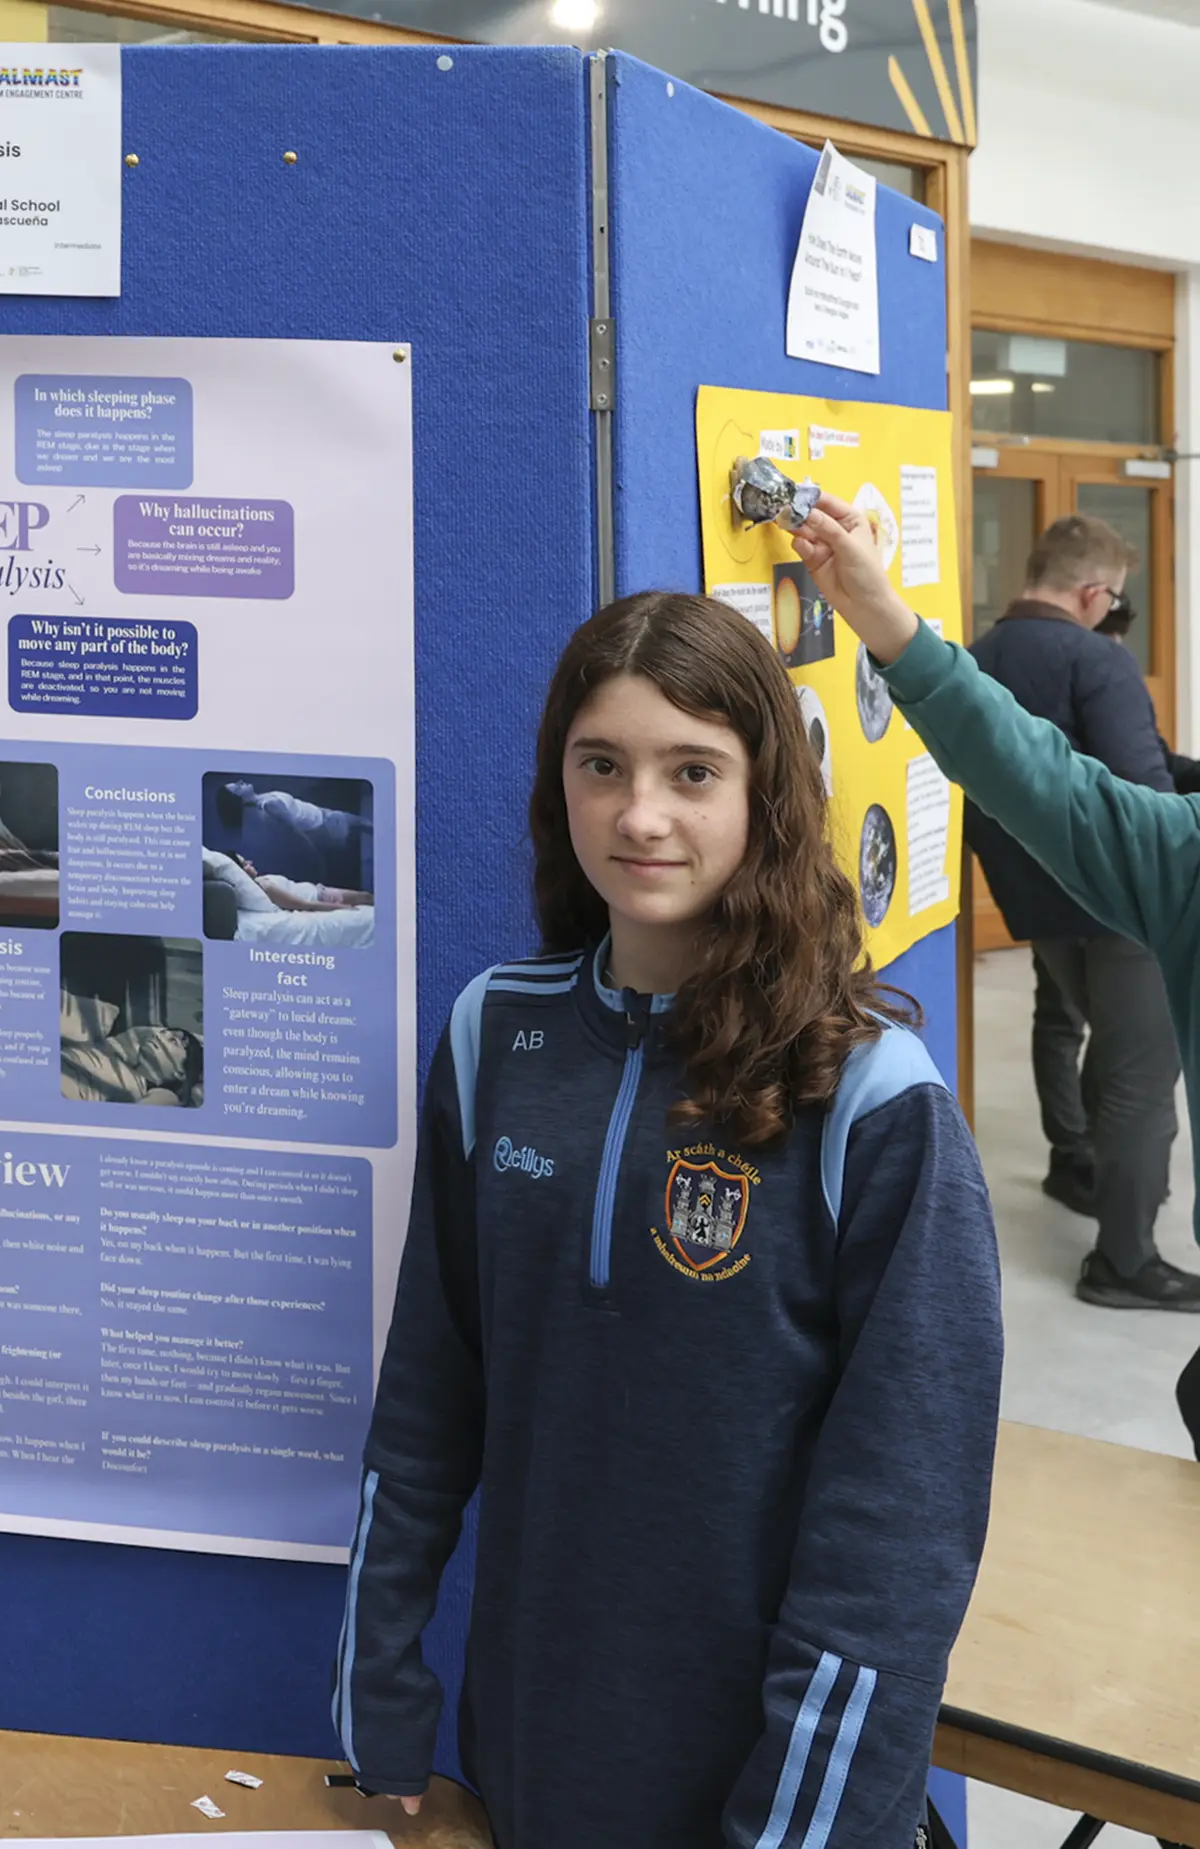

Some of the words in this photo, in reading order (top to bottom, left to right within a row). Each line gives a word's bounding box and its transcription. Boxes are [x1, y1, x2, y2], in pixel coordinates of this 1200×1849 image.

[5, 89, 53, 98] ENGAGEMENT
[55, 90, 82, 98] CENTRE
[10, 198, 60, 212] School
[35, 388, 47, 401] In
[50, 389, 85, 403] which
[88, 390, 138, 406] sleeping
[140, 391, 176, 407] phase
[54, 404, 82, 416] does
[85, 404, 94, 417] it
[96, 404, 152, 421] happens?
[139, 502, 170, 521] Why
[174, 504, 274, 520] hallucinations
[169, 525, 194, 536] can
[197, 523, 244, 537] occur?
[31, 620, 58, 638] Why
[94, 622, 103, 636] it
[107, 625, 159, 642] possible
[162, 628, 175, 640] to
[18, 639, 52, 650] move
[54, 640, 77, 654] any
[81, 641, 107, 655] part
[111, 637, 125, 652] of
[127, 640, 148, 654] the
[151, 641, 188, 658] body?
[20, 658, 54, 667] Because
[58, 660, 80, 669] sleep
[83, 662, 118, 670] paralysis
[122, 663, 156, 672] happens
[172, 665, 185, 673] the
[20, 670, 40, 678] REM
[67, 672, 83, 680] and
[94, 673, 110, 681] that
[137, 675, 151, 683] the
[20, 693, 41, 701] while
[156, 689, 185, 697] moving
[84, 786, 175, 802] Conclusions
[249, 949, 335, 969] Interesting
[277, 971, 307, 986] fact
[222, 987, 249, 1002] Sleep
[250, 990, 294, 1004] paralysis
[295, 995, 313, 1003] can
[315, 996, 330, 1004] act
[344, 998, 350, 1006] a
[278, 1012, 289, 1021] to
[291, 1010, 315, 1023] lucid
[317, 1012, 355, 1024] dreams:
[222, 1028, 245, 1037] even
[247, 1027, 283, 1042] though
[285, 1029, 300, 1040] the
[302, 1030, 326, 1045] body
[330, 1032, 337, 1043] is
[512, 1030, 545, 1052] AB
[223, 1045, 274, 1059] paralyzed,
[276, 1048, 291, 1059] the
[293, 1049, 319, 1061] mind
[321, 1053, 360, 1063] remains
[222, 1064, 273, 1077] conscious,
[275, 1066, 319, 1082] allowing
[320, 1073, 339, 1083] you
[342, 1073, 353, 1082] to
[222, 1084, 248, 1094] enter
[250, 1087, 257, 1095] a
[258, 1084, 289, 1097] dream
[291, 1087, 318, 1099] while
[320, 1089, 365, 1105] knowing
[256, 1104, 306, 1119] dreaming.
[665, 1150, 682, 1162] Ar
[717, 1150, 725, 1158] a
[99, 1282, 116, 1292] Did
[116, 1286, 136, 1295] your
[136, 1286, 159, 1298] sleep
[160, 1289, 191, 1299] routine
[192, 1291, 222, 1303] change
[224, 1294, 244, 1304] after
[246, 1296, 269, 1305] those
[271, 1300, 325, 1310] experiences?
